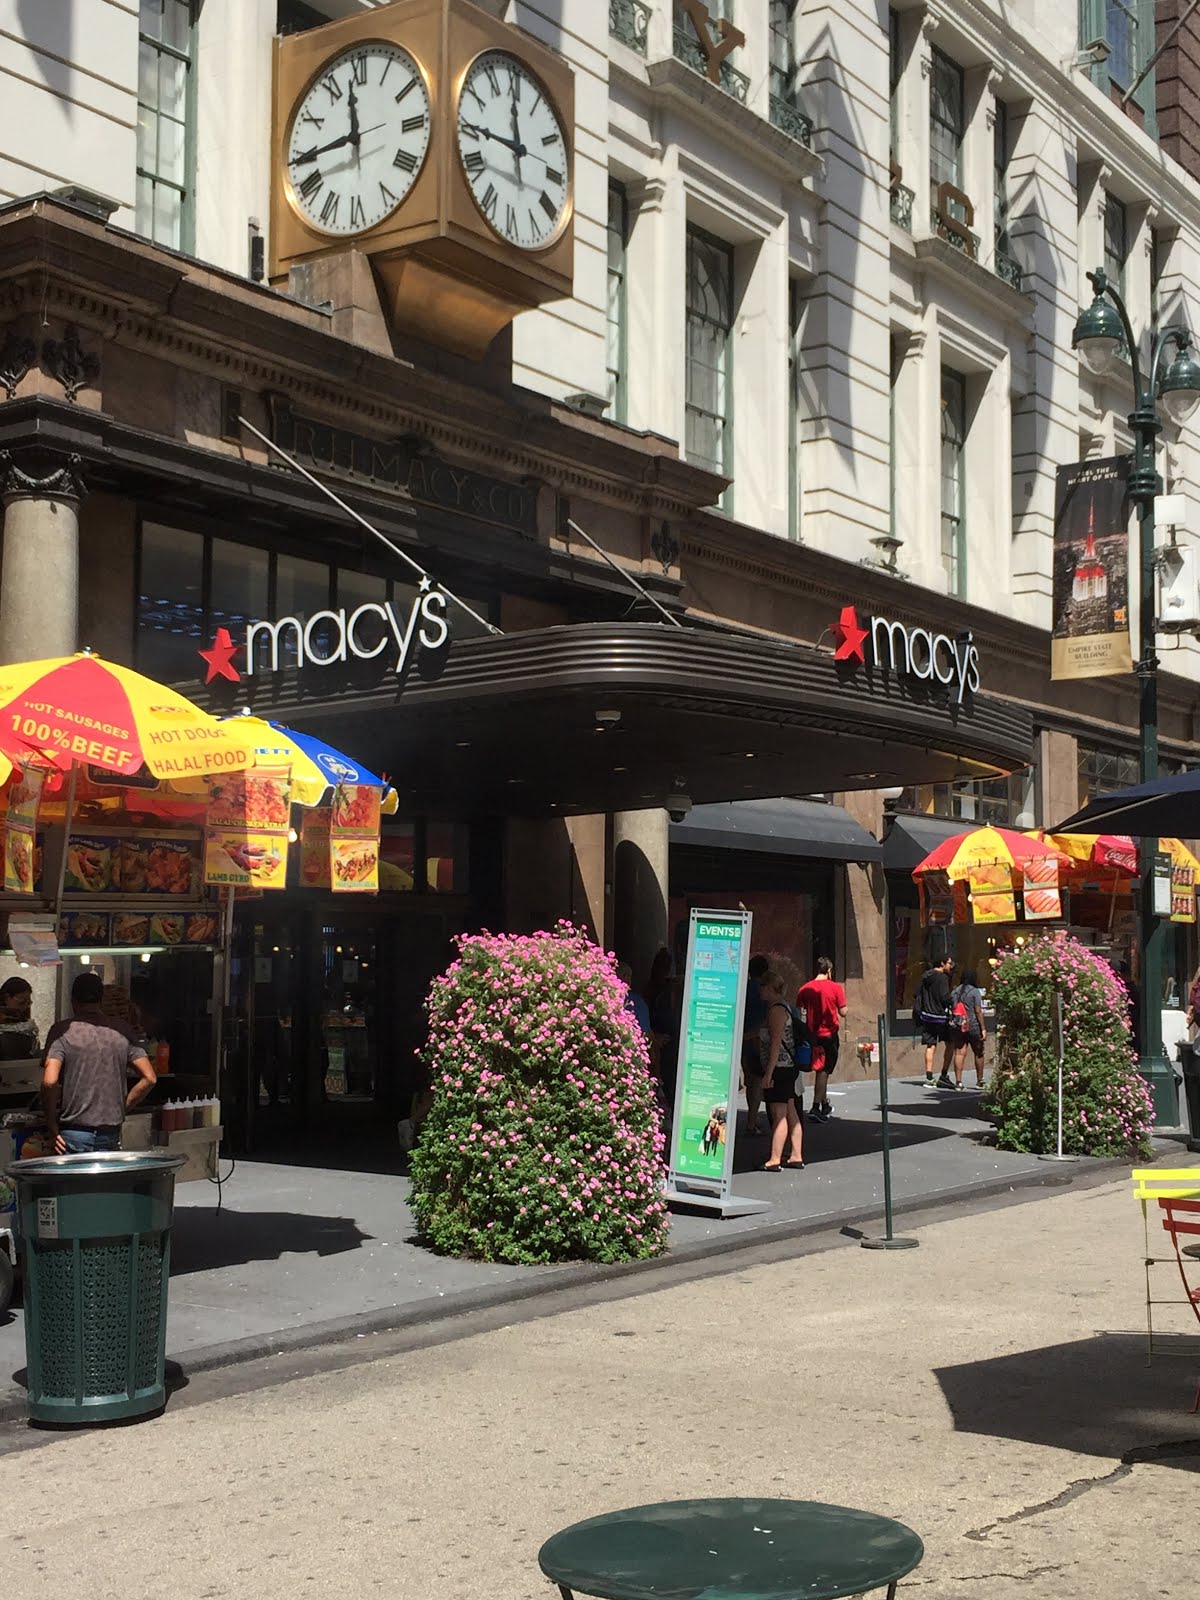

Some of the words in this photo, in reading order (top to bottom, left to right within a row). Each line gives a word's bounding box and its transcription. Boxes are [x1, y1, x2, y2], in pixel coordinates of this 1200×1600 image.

[55, 708, 130, 740] SAUSAGES
[149, 729, 182, 745] HOT
[153, 756, 203, 773] HALAL
[204, 750, 247, 768] FOOD
[699, 925, 735, 937] EVENTS
